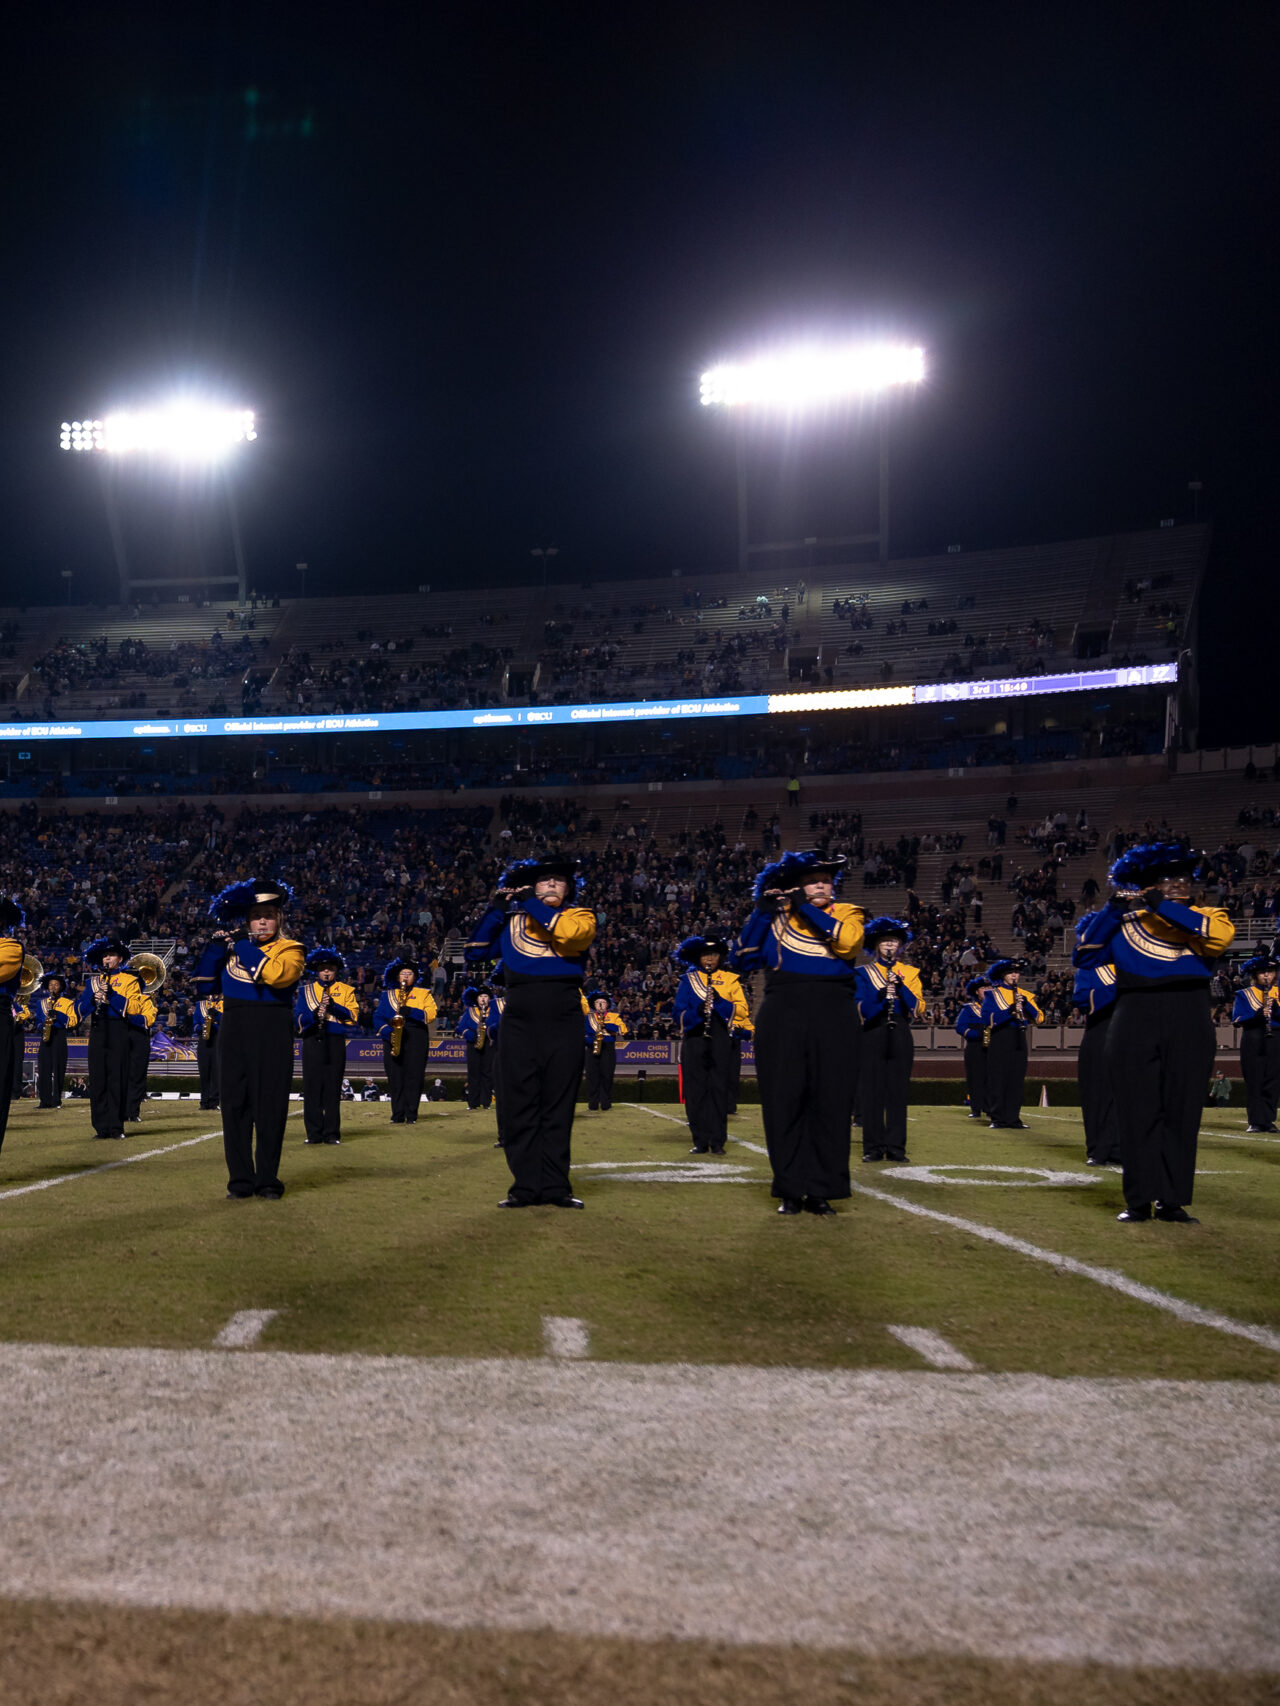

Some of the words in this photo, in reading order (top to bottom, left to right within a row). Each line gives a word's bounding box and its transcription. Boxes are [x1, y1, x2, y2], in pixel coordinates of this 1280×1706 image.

[972, 685, 990, 694] 3rd
[671, 705, 680, 714] of
[681, 704, 701, 713] ECU
[316, 720, 325, 729] of
[326, 719, 344, 728] ECU
[22, 727, 31, 736] of
[31, 727, 49, 735] ECU
[429, 1050, 465, 1058] UMPLER
[624, 1051, 669, 1059] JOHNSON
